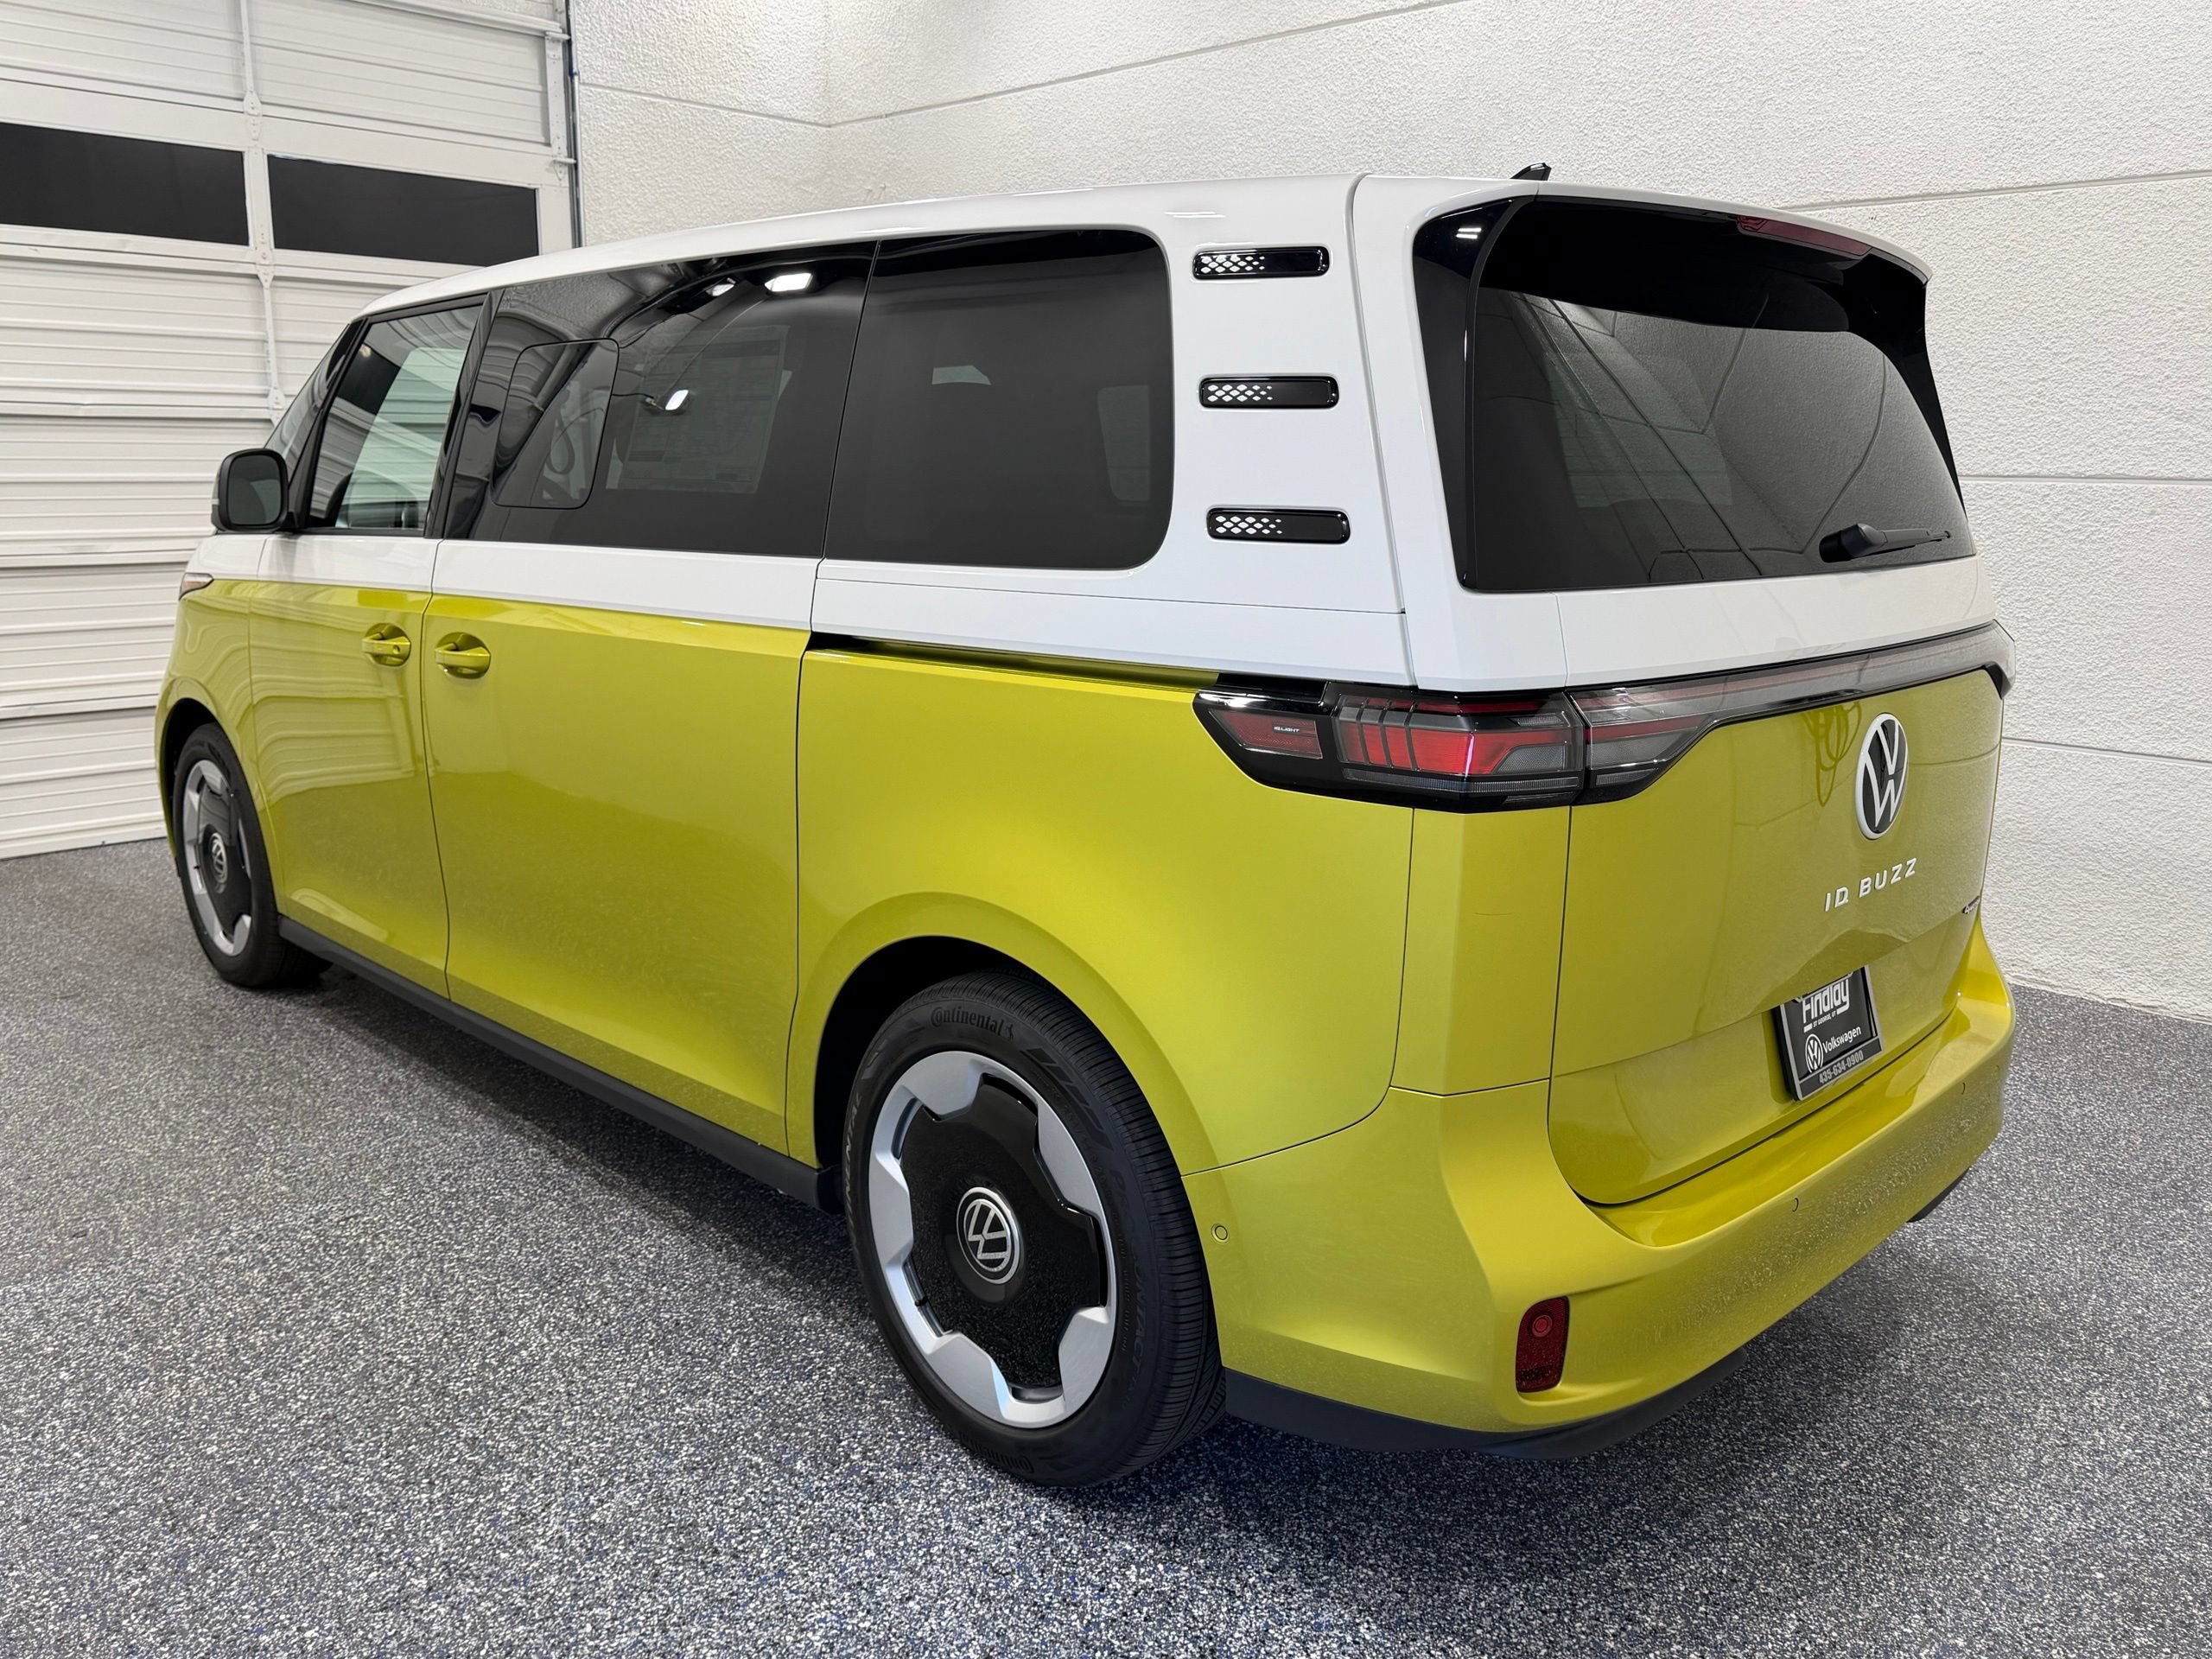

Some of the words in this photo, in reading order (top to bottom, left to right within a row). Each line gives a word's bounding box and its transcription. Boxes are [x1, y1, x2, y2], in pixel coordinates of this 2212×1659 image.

[1857, 714, 1907, 839] VW
[1859, 857, 1917, 898] BUZZ
[1802, 978, 1850, 1024] Findlay
[931, 1006, 1004, 1036] Continental
[1822, 1026, 1862, 1053] Volkswagen
[1819, 1050, 1864, 1084] 435-634-0900
